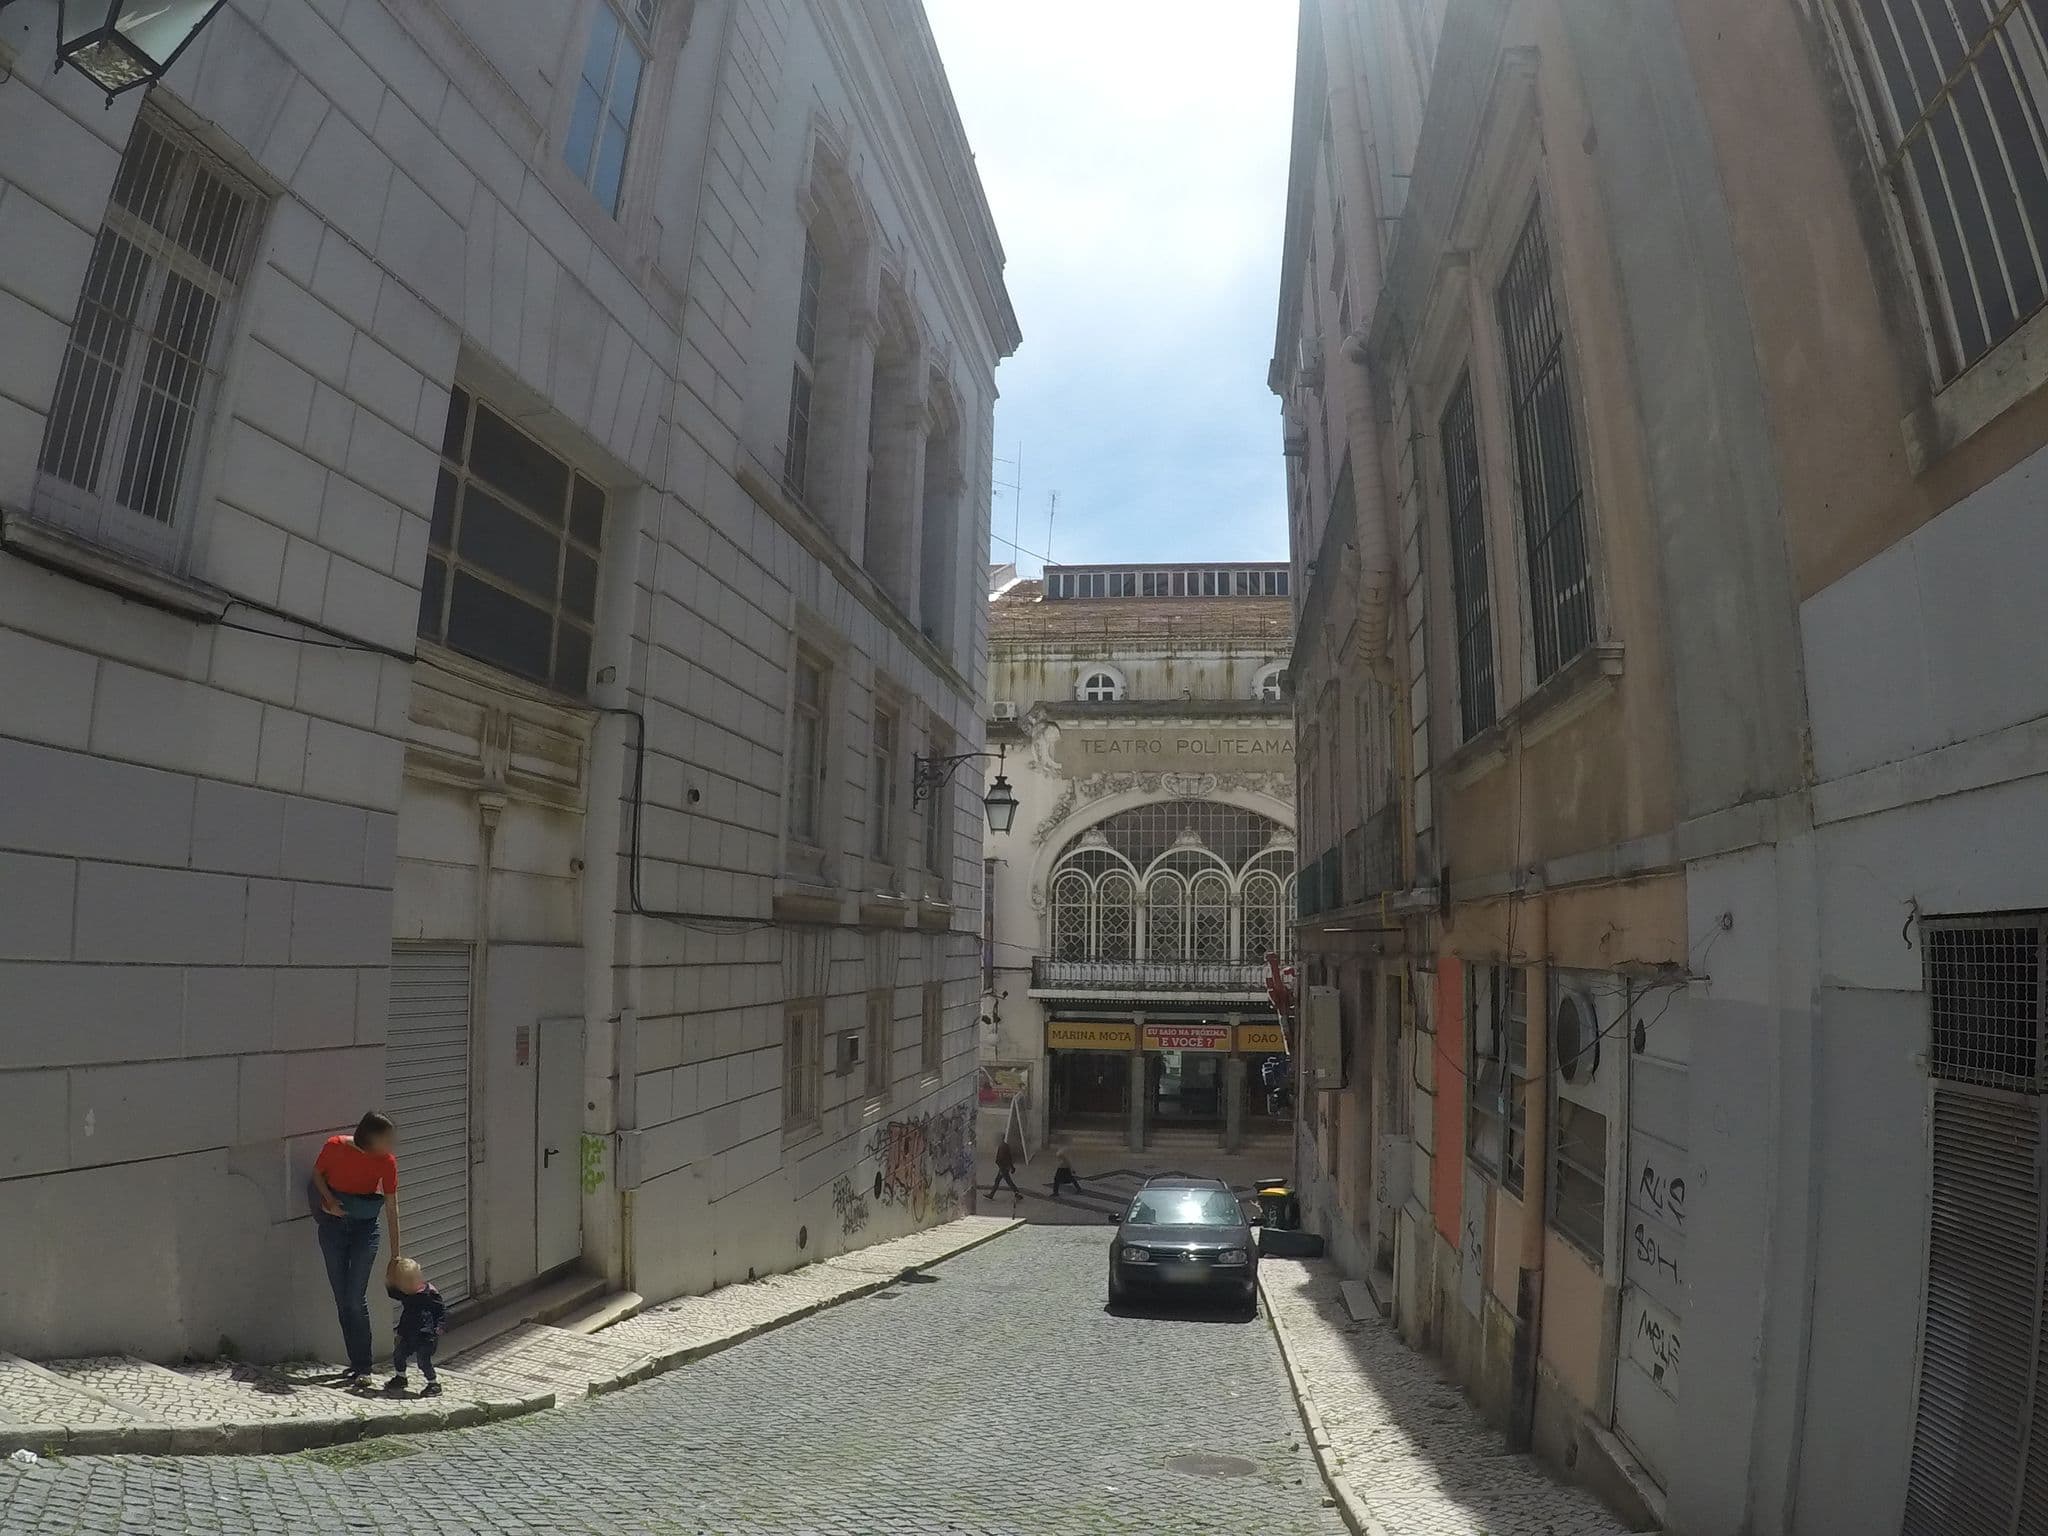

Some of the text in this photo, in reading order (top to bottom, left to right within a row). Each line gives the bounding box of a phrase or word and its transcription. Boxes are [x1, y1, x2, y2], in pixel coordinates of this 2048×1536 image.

[1081, 739, 1295, 754] TEATRO POLITEAMA
[1052, 1030, 1131, 1041] MARINA MOTA
[1162, 1037, 1169, 1047] E
